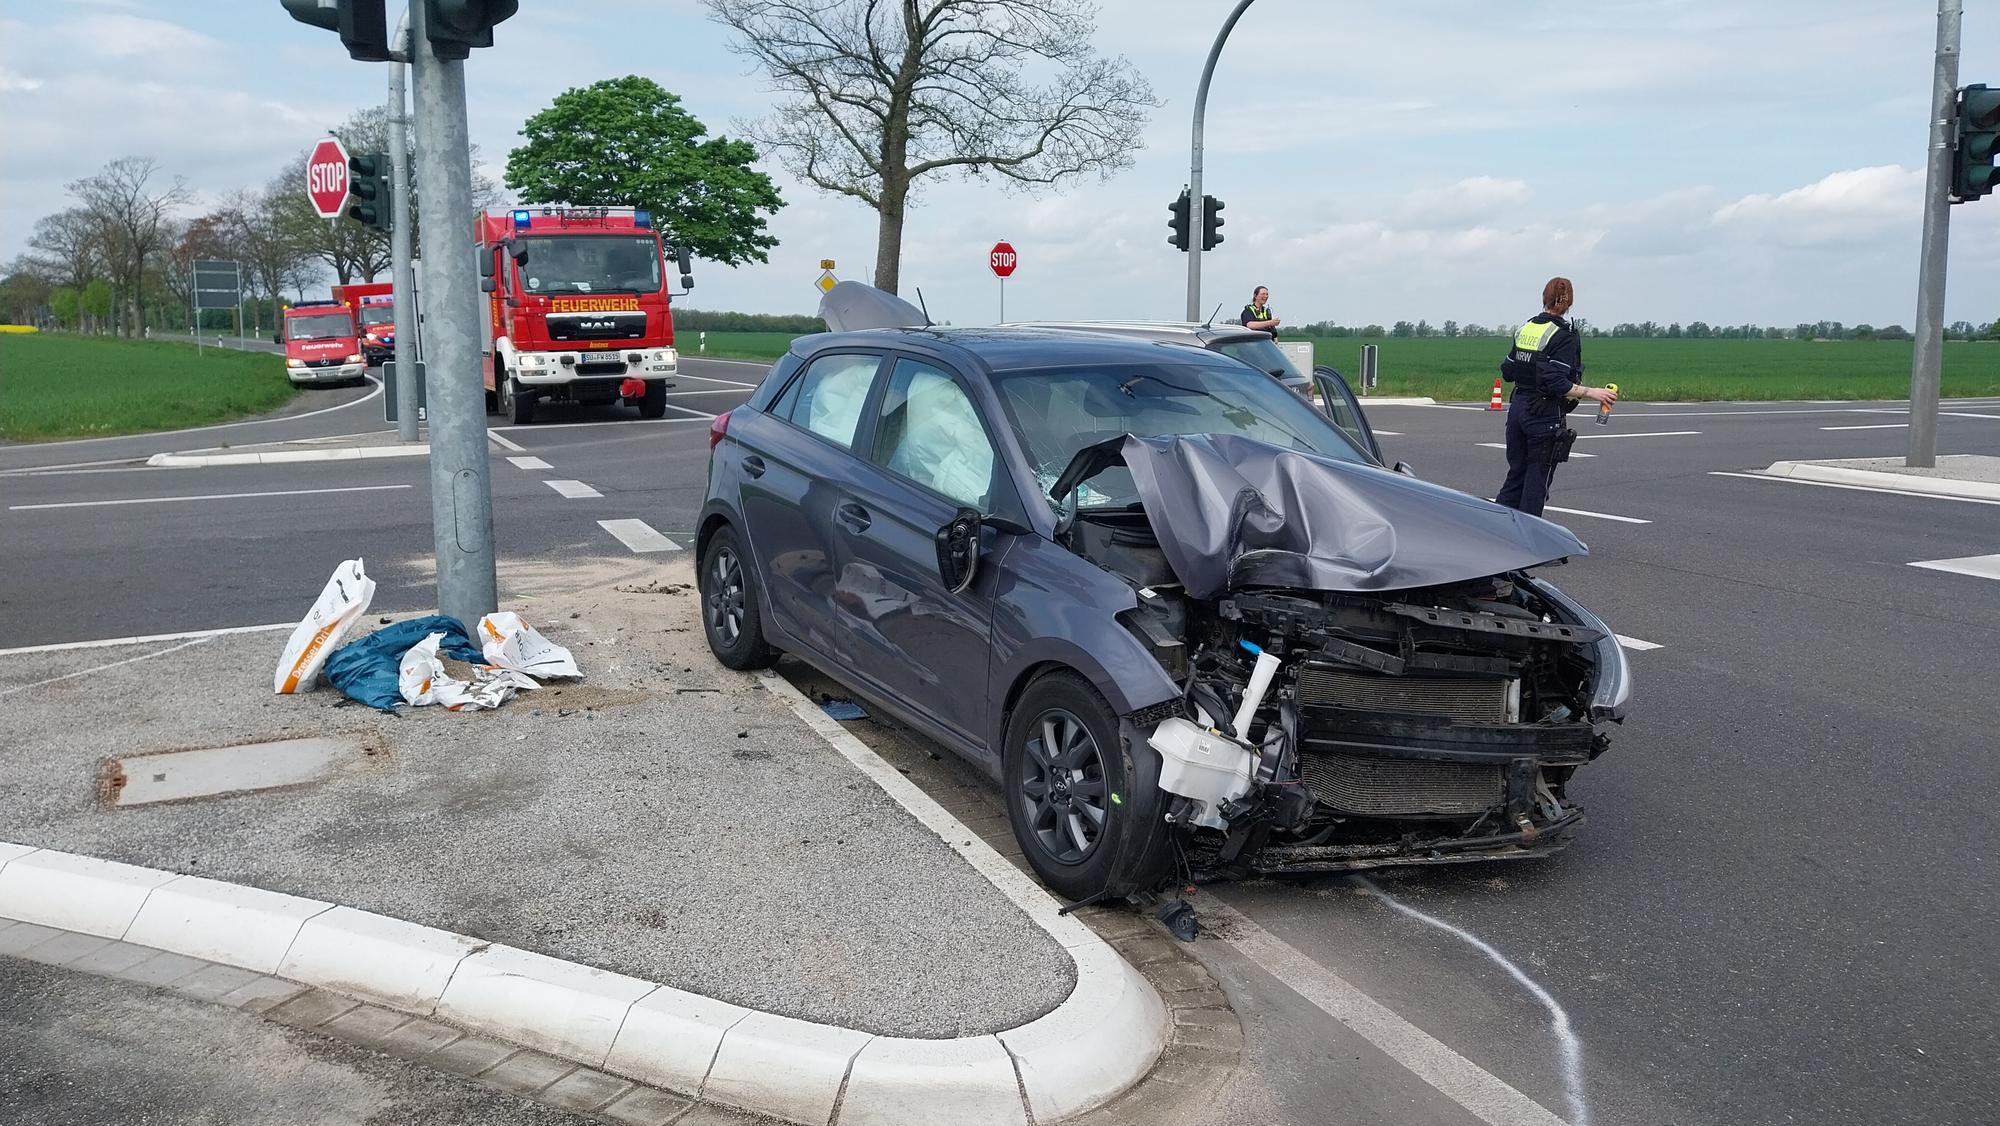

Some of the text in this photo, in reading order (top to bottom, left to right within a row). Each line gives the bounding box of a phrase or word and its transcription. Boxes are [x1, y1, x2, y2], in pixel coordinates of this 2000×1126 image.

[311, 162, 345, 193] STOP
[992, 252, 1016, 267] STOP
[552, 299, 640, 312] FEUERWEHR
[580, 322, 615, 330] MAN
[1515, 351, 1532, 362] NRW
[291, 644, 319, 679] Dresser
